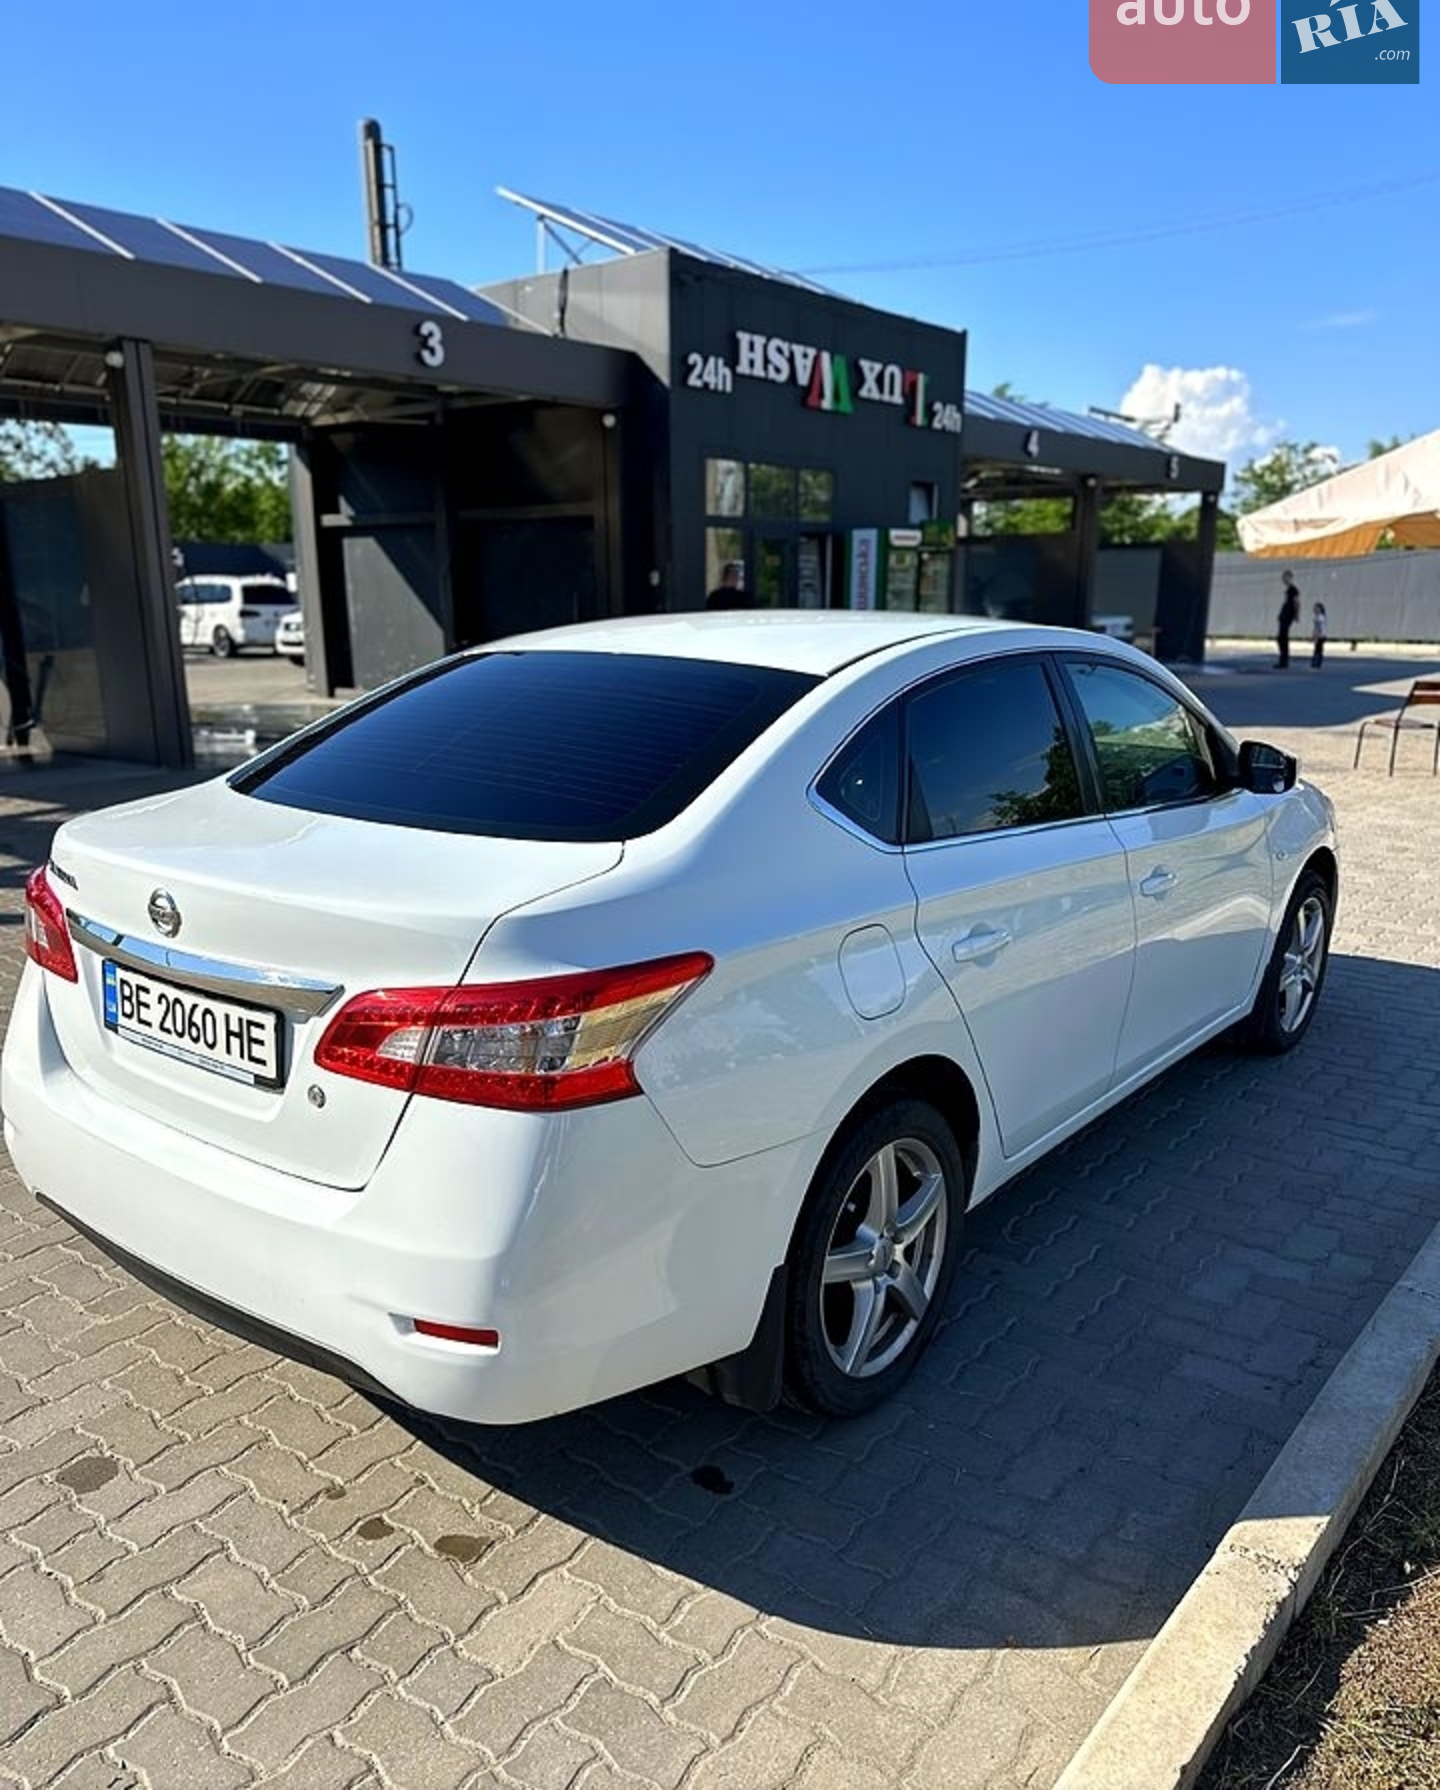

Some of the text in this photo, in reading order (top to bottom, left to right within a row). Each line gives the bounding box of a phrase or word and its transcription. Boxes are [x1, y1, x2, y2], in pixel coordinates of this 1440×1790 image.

[419, 320, 445, 367] 3
[687, 352, 733, 393] 24h
[736, 330, 853, 415] WASH
[932, 402, 962, 433] 24h
[1027, 429, 1040, 459] 4
[119, 977, 153, 1029] BE
[157, 993, 217, 1051] 2060
[224, 1012, 268, 1067] HE
